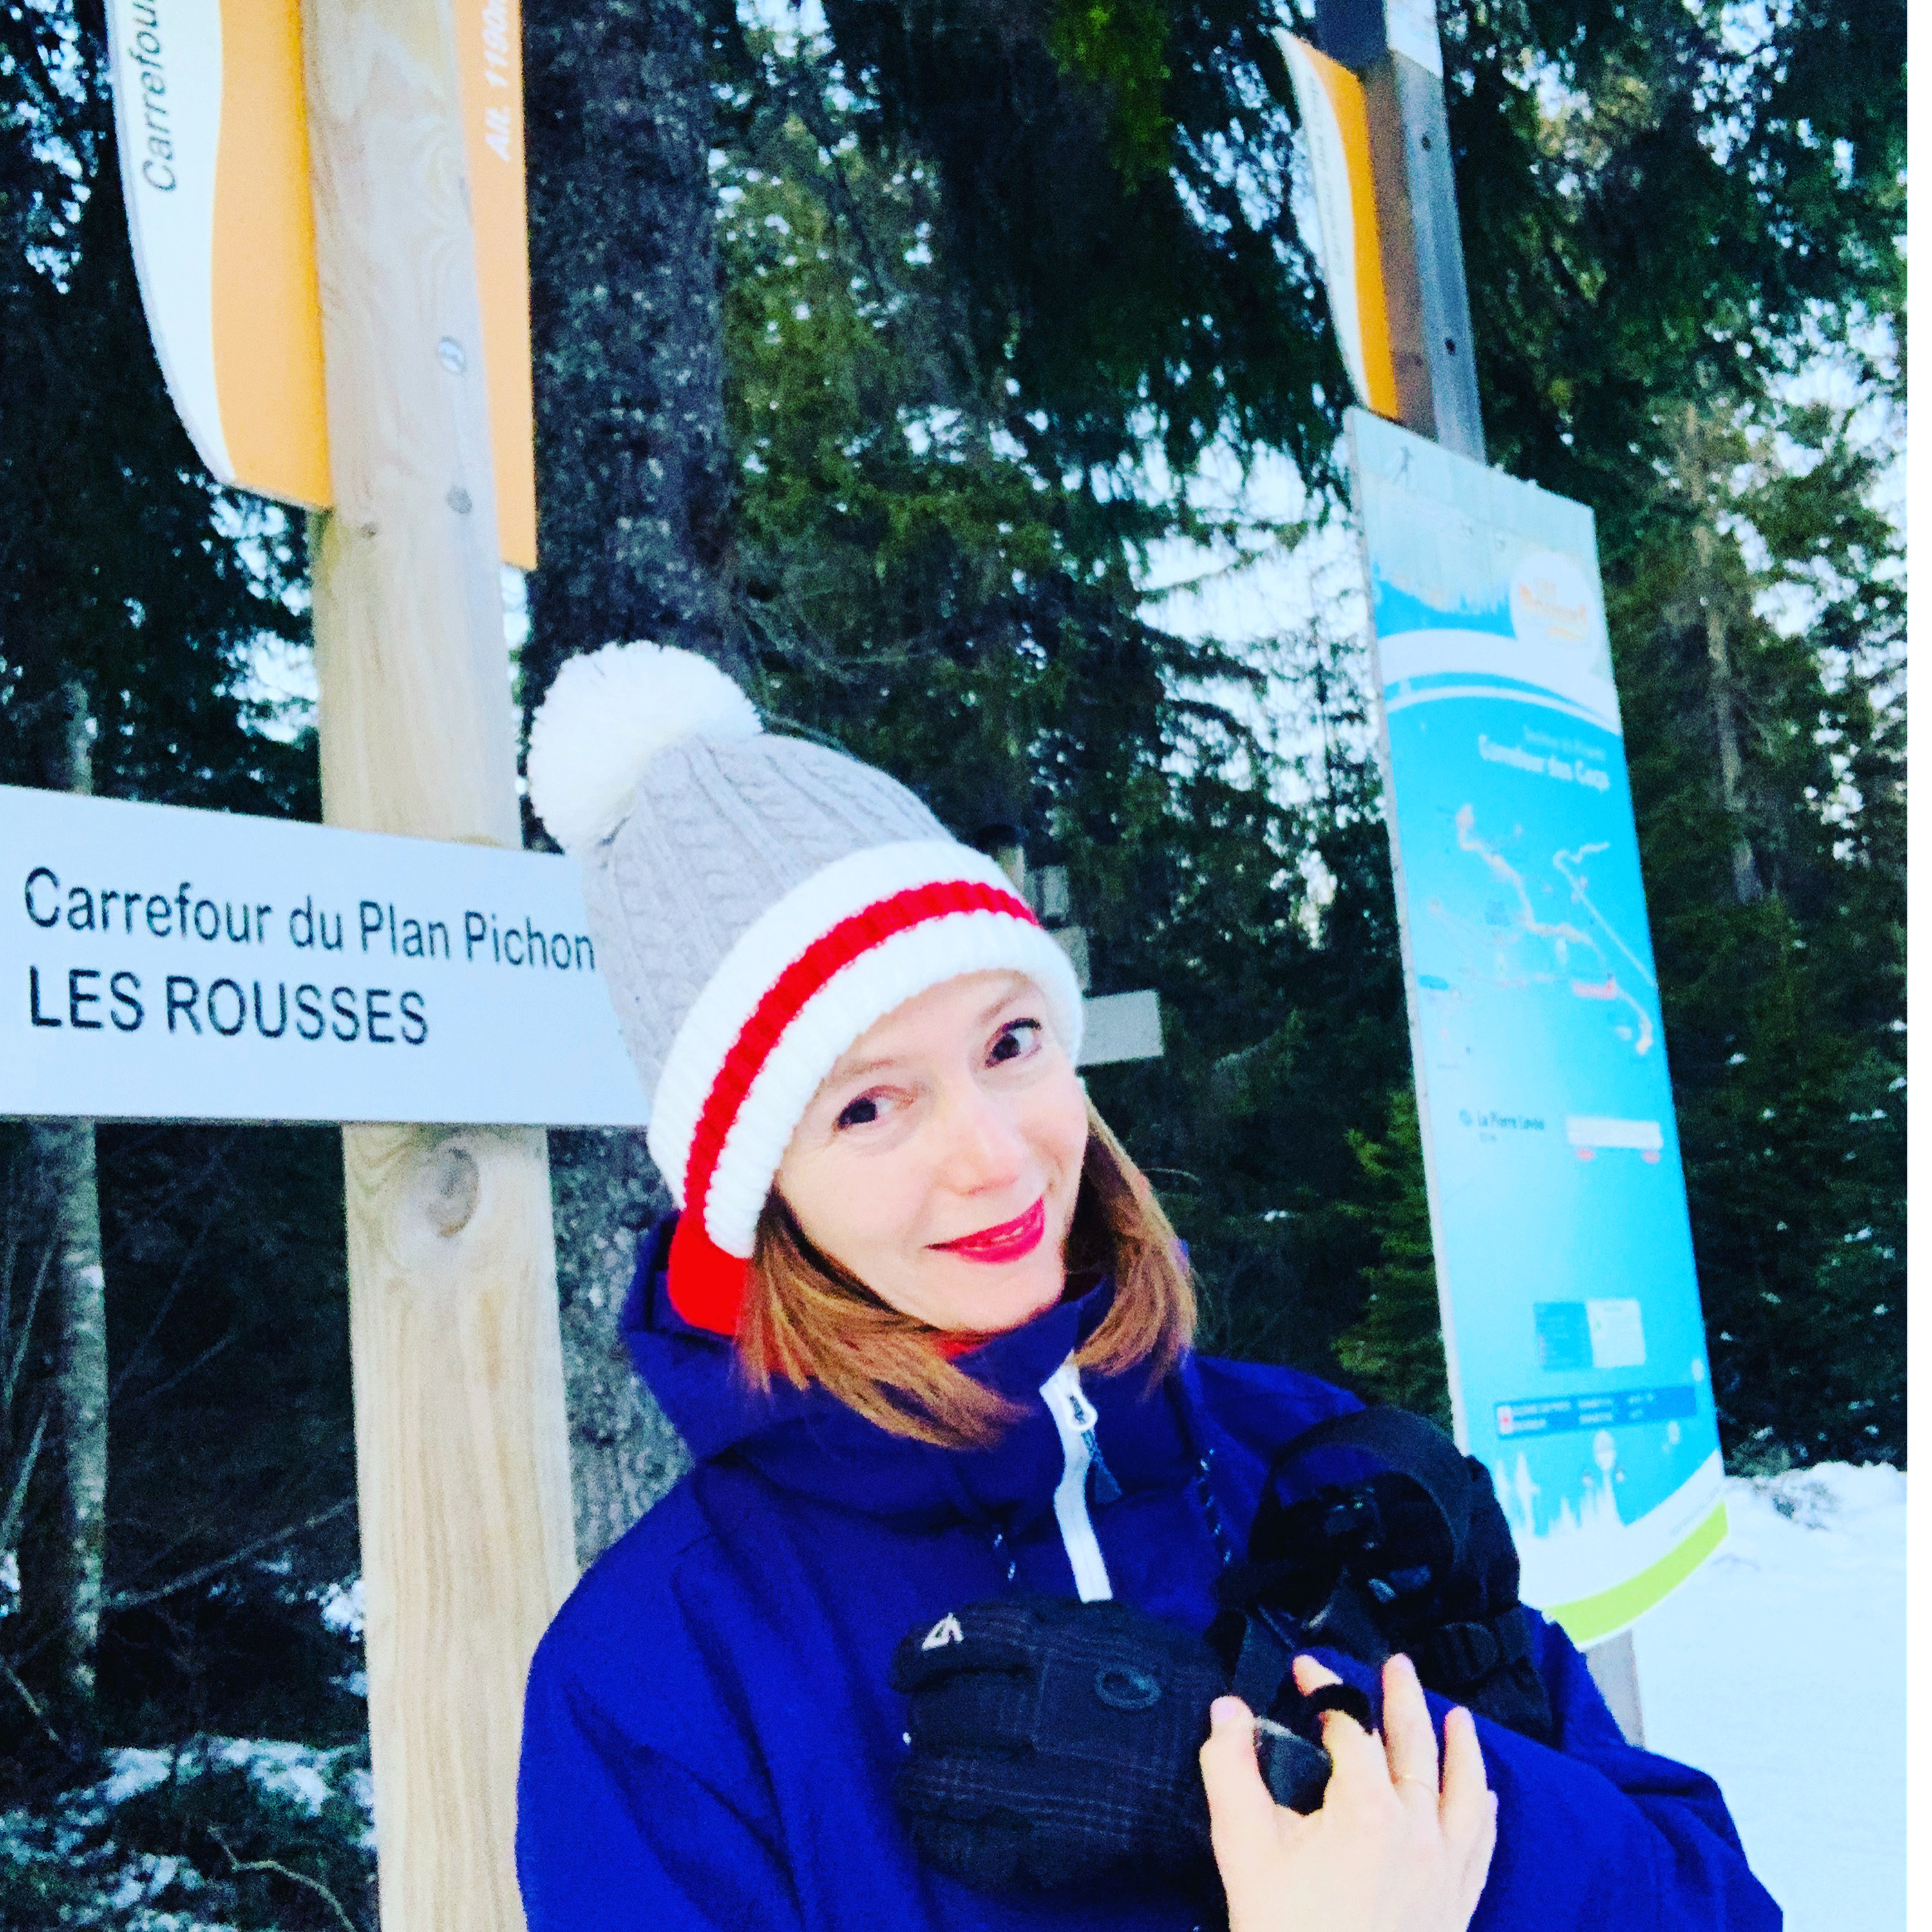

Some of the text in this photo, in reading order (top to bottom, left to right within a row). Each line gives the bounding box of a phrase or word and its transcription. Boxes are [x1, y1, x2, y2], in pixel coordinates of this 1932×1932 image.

[482, 0, 509, 87] 1190
[127, 0, 177, 193] Carrefou
[24, 866, 595, 971] Carrefour du Plan Pichon
[29, 965, 429, 1046] LES ROUSSES
